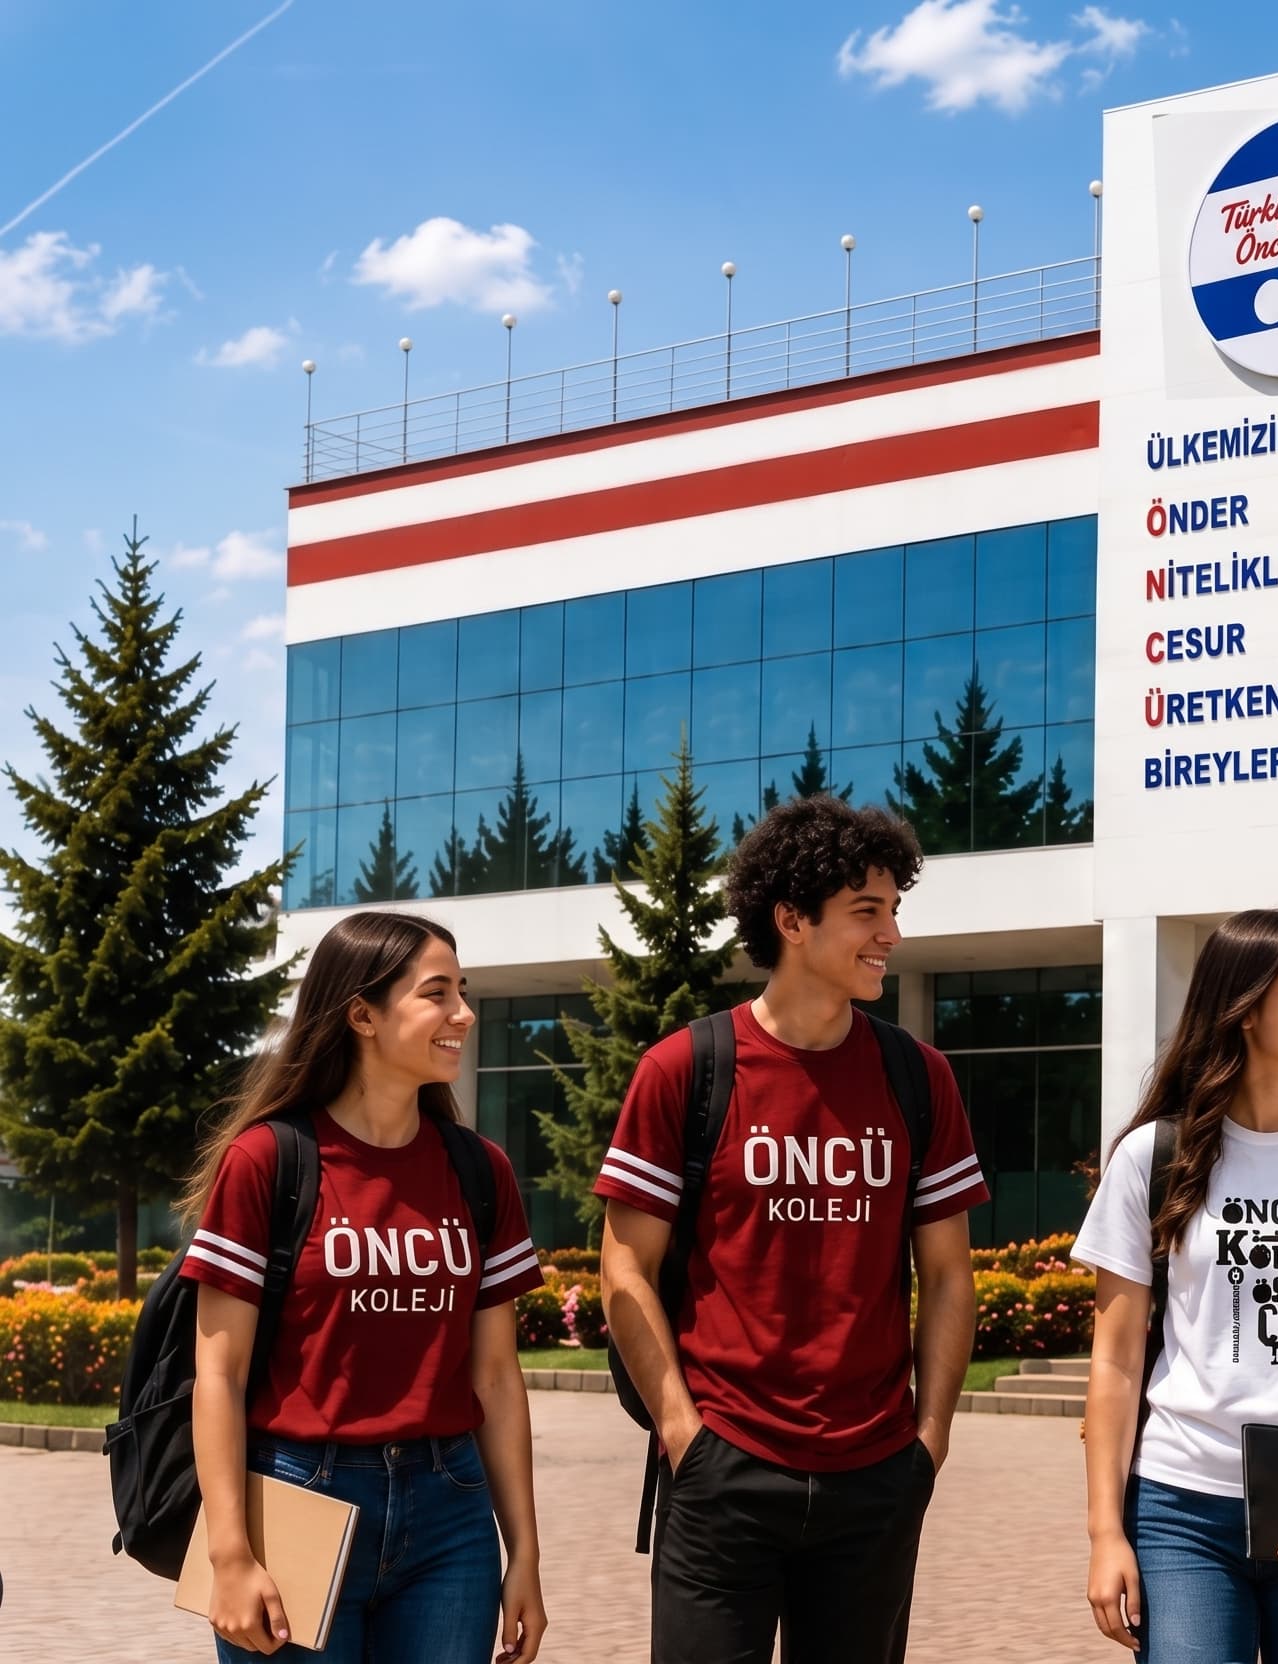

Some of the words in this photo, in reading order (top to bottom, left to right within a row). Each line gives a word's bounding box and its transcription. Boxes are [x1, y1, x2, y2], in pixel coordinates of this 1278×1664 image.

[1146, 494, 1249, 537] ÖNDER
[1146, 623, 1246, 665] CESUR
[744, 1125, 893, 1187] ÖNCÜ
[768, 1194, 871, 1222] KOLEJİ
[324, 1217, 472, 1277] ÖNCÜ
[350, 1285, 455, 1313] KOLEJİ
